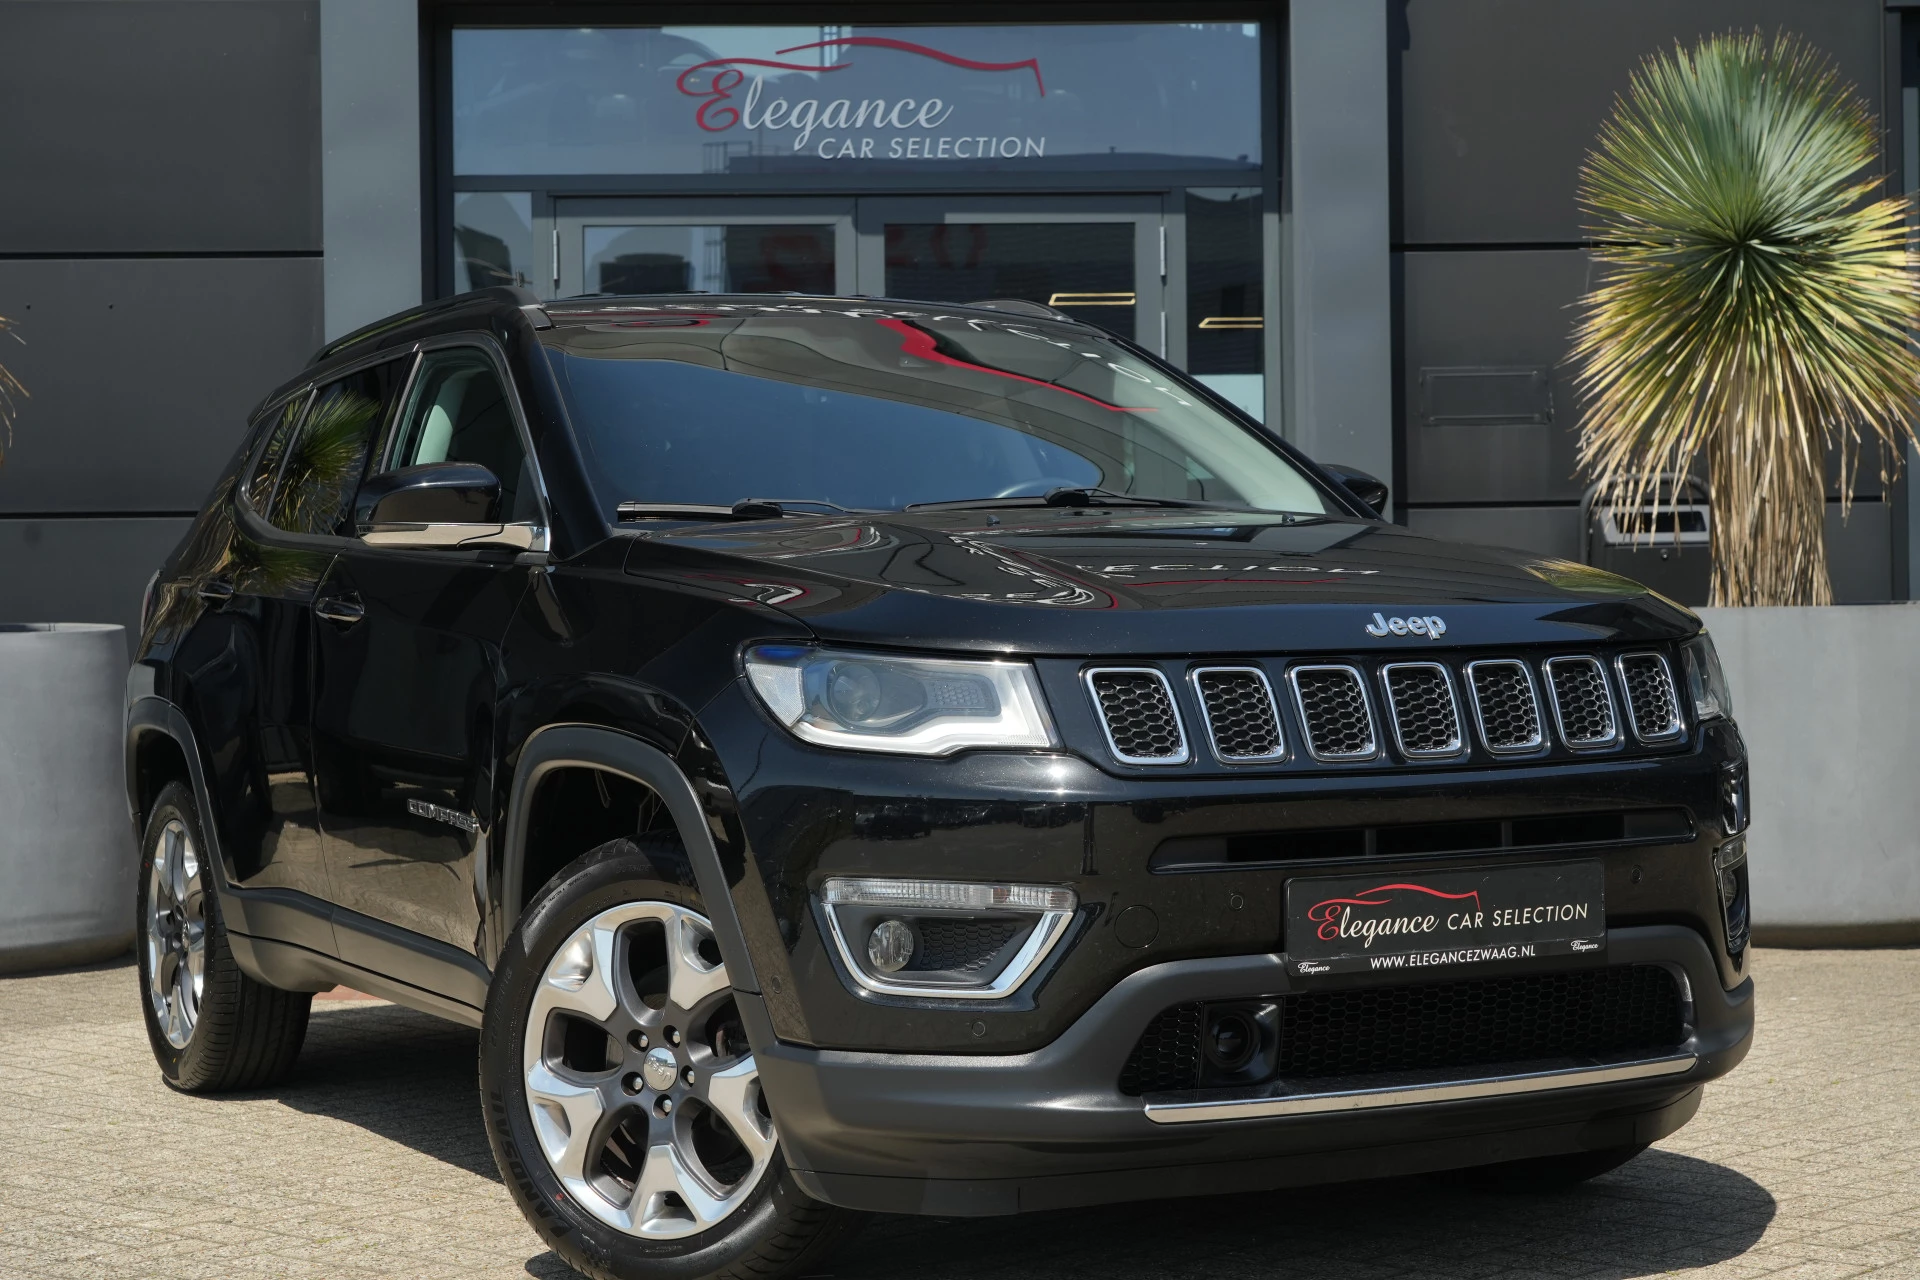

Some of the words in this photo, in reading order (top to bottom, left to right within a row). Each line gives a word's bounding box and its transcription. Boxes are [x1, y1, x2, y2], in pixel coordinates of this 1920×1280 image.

[677, 58, 954, 152] Elegance
[818, 137, 874, 160] CAR
[888, 136, 1046, 159] SELECTION
[1365, 612, 1447, 641] Jeep
[1307, 898, 1440, 949] Elegance
[1447, 911, 1484, 930] CAR
[1492, 902, 1589, 927] SELECTION
[1370, 945, 1536, 970] WWW.ELEGANCEZWAAG.NL
[1571, 939, 1599, 951] Elegance
[1297, 961, 1331, 974] Elegance
